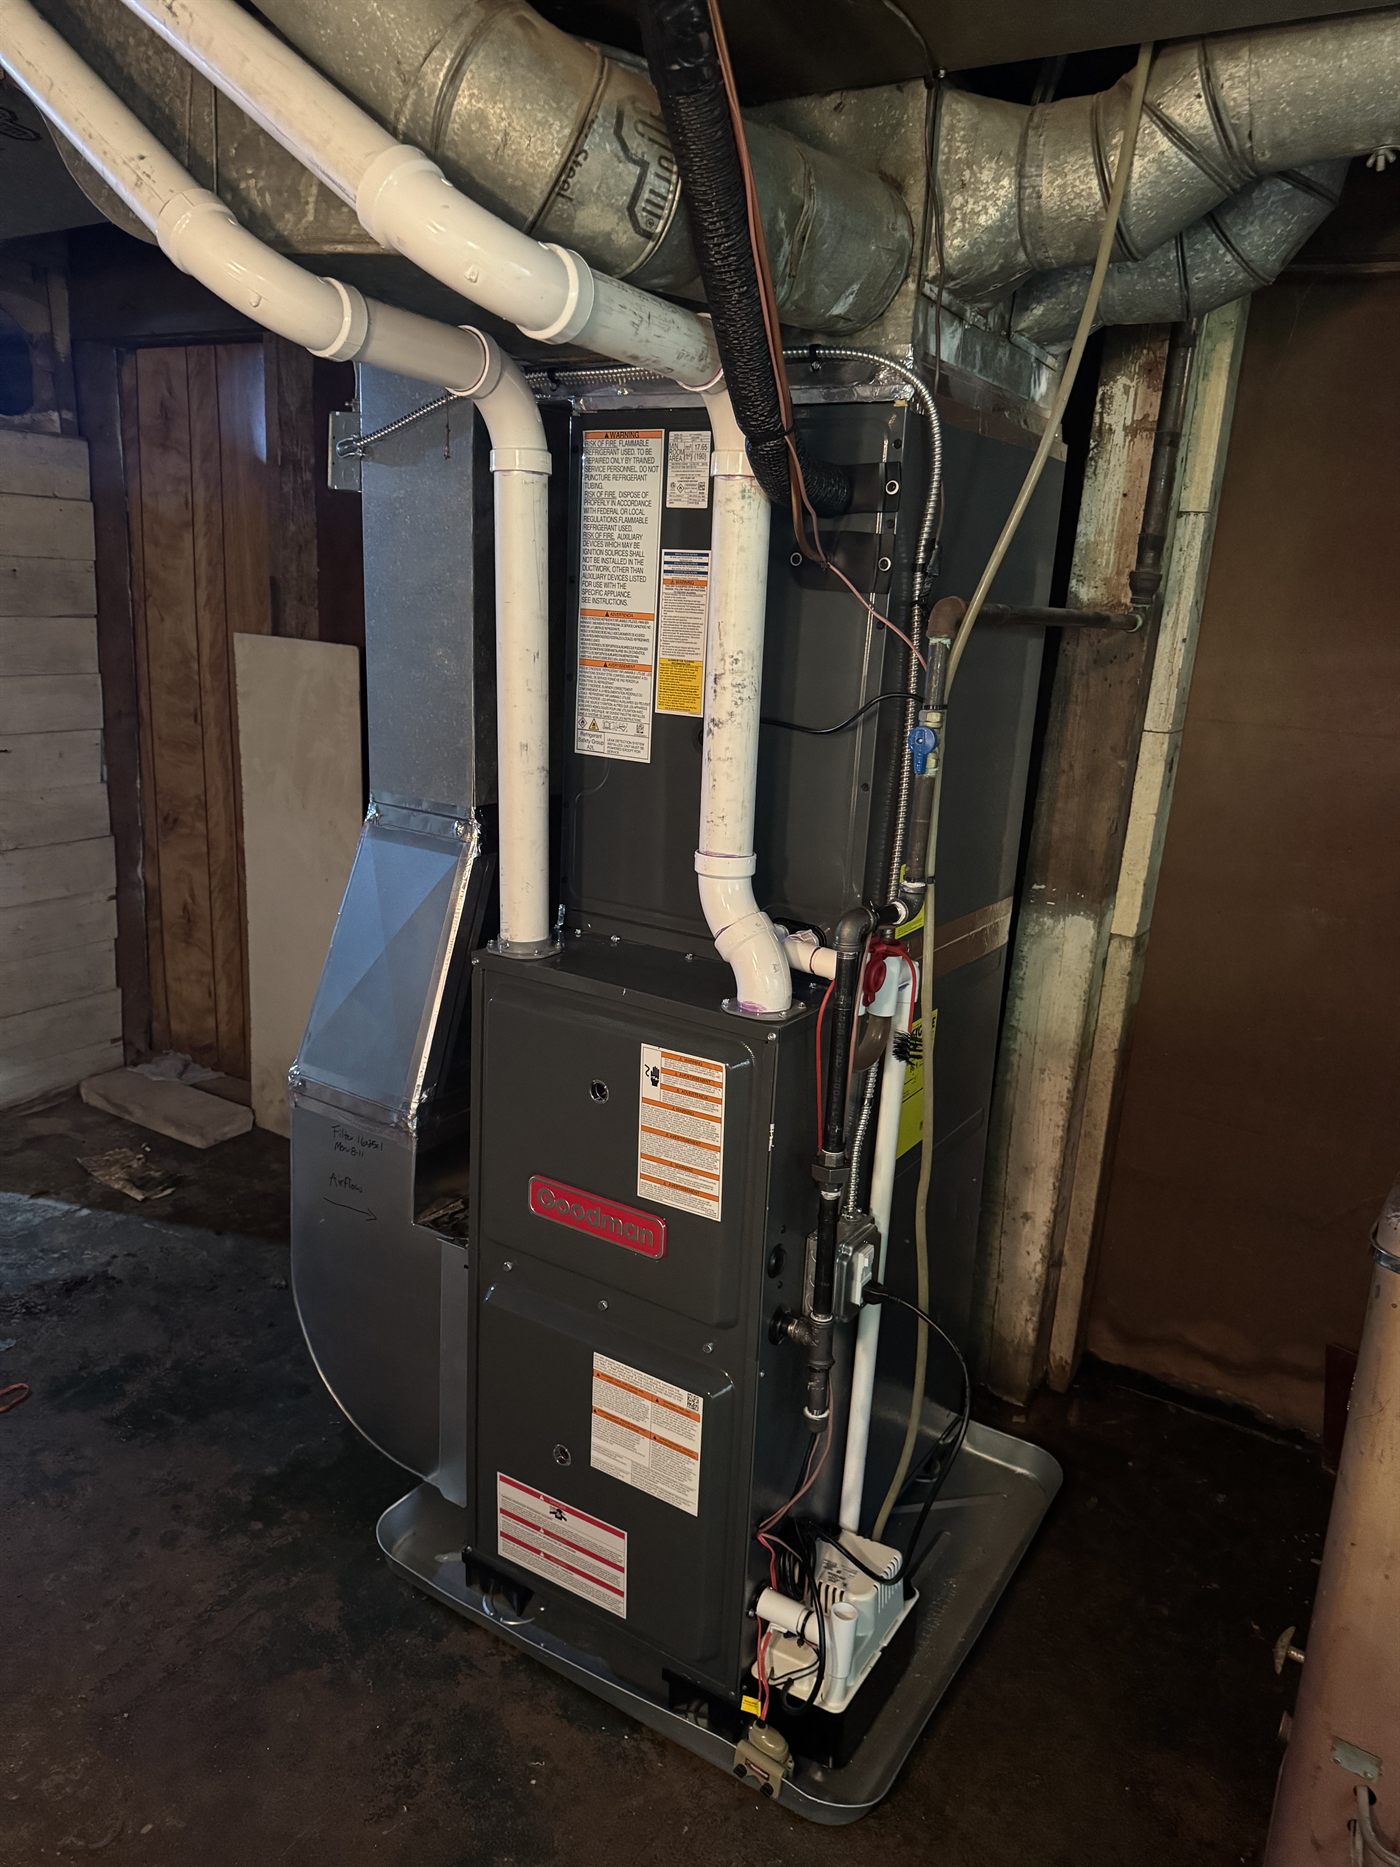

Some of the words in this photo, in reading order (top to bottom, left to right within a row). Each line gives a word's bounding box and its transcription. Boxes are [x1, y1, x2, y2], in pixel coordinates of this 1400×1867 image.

[556, 148, 589, 202] Steel
[584, 448, 619, 456] REFRIGERANT
[637, 448, 644, 456] TO
[645, 448, 652, 456] BE
[583, 524, 617, 532] REFRIGERANT
[604, 549, 628, 557] SOURCES
[629, 550, 645, 558] SHALL
[630, 566, 644, 574] THAN
[608, 574, 628, 582] DEVICES
[629, 575, 646, 583] LISTED
[580, 731, 602, 739] Refrigerant
[331, 1125, 353, 1141] Filter
[329, 1172, 363, 1193] Airflow
[537, 1188, 654, 1248] Goodman
